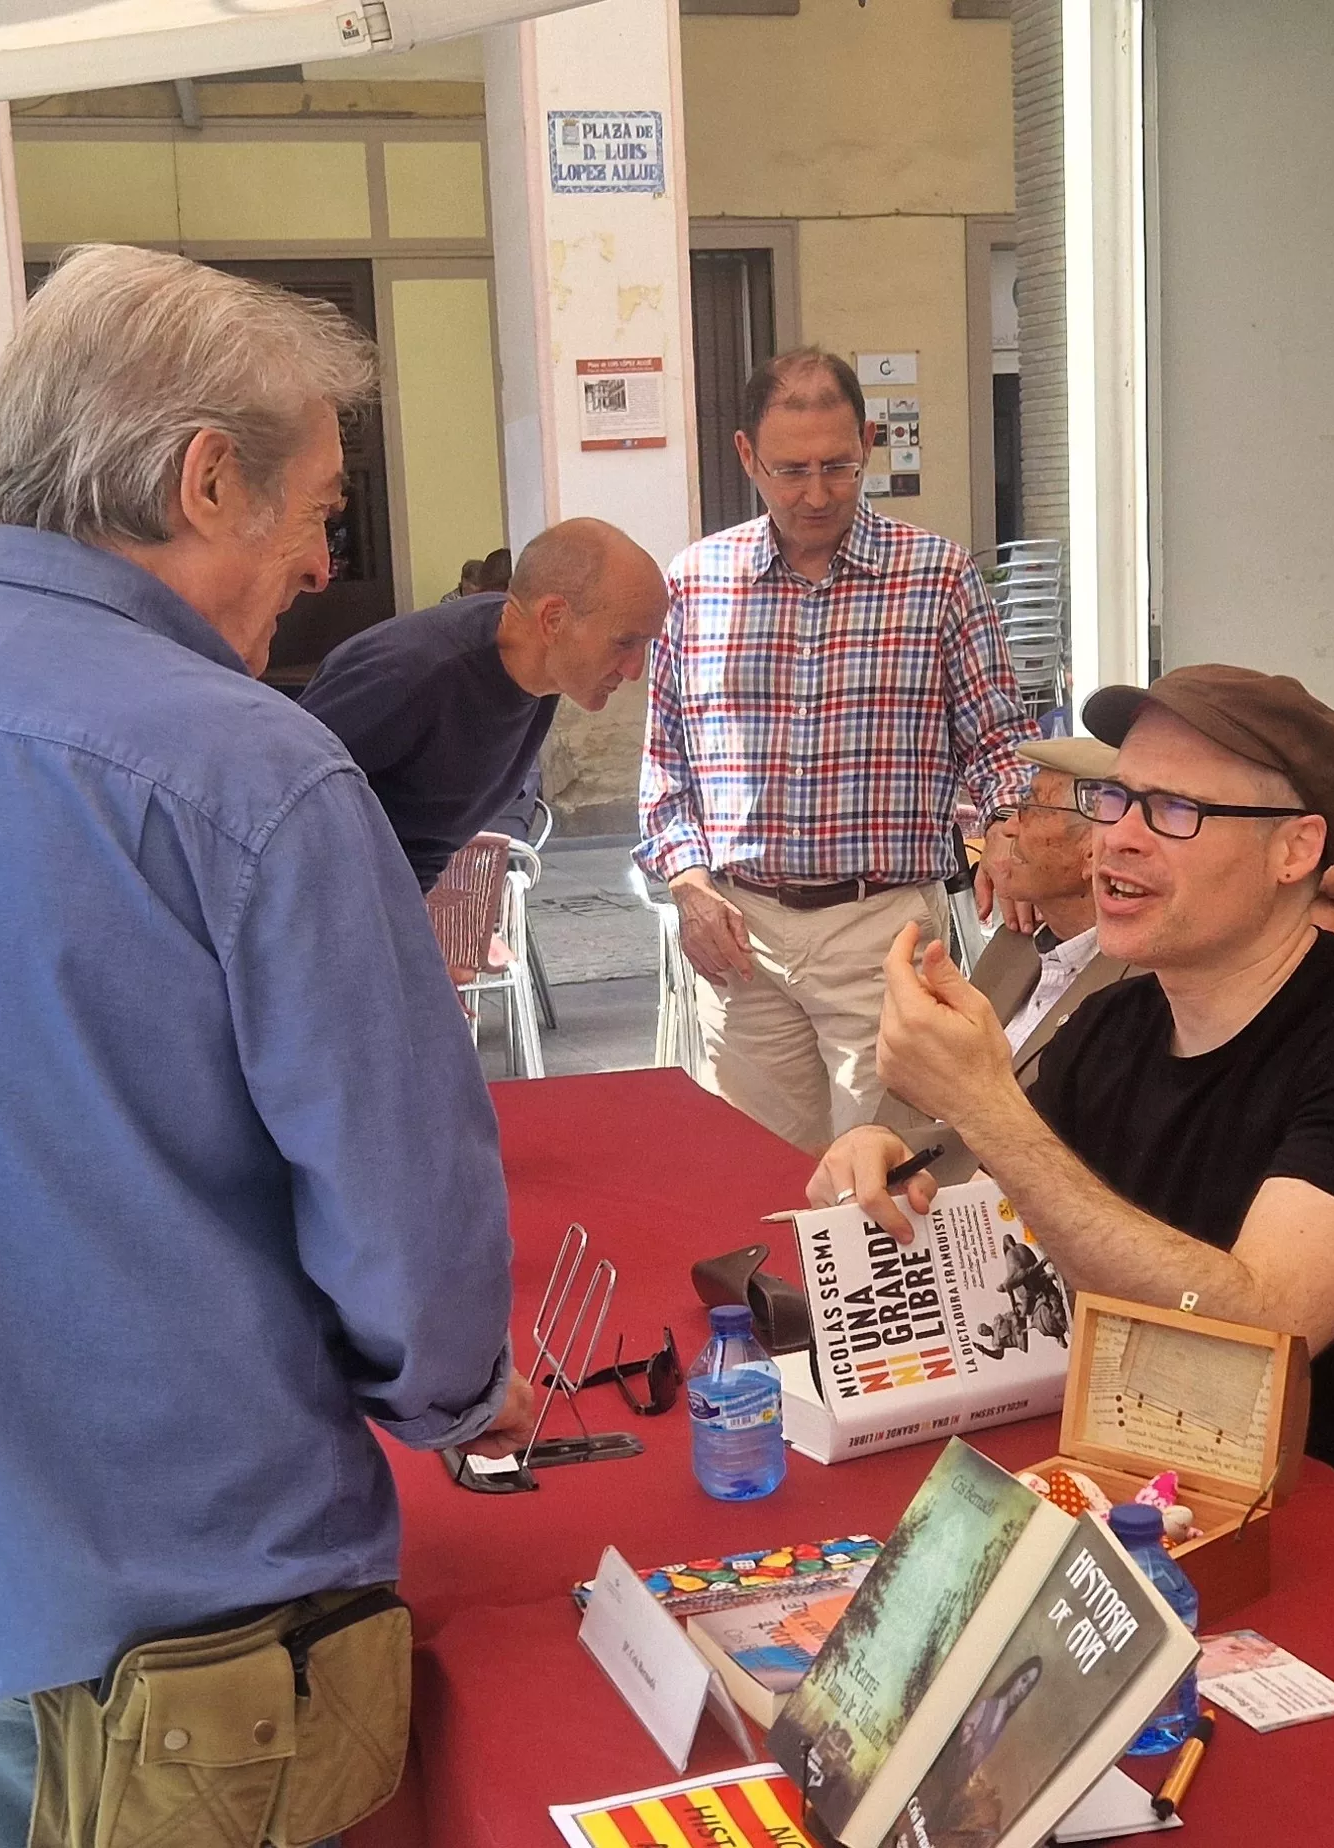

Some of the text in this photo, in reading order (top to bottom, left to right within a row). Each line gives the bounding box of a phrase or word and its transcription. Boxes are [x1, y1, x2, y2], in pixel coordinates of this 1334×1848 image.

[558, 164, 606, 181] LOPEZ
[582, 123, 653, 139] PLAZA DE
[605, 143, 647, 160] LUIS
[811, 1228, 860, 1399] NICOLÁS SESMA
[844, 1284, 894, 1394] NI UNA
[901, 1248, 957, 1380] NI LIBRE
[931, 1208, 979, 1374] LA DICTADURA FRANQUISTA
[888, 1352, 925, 1388] NI
[1065, 1547, 1139, 1653] HISTORIA
